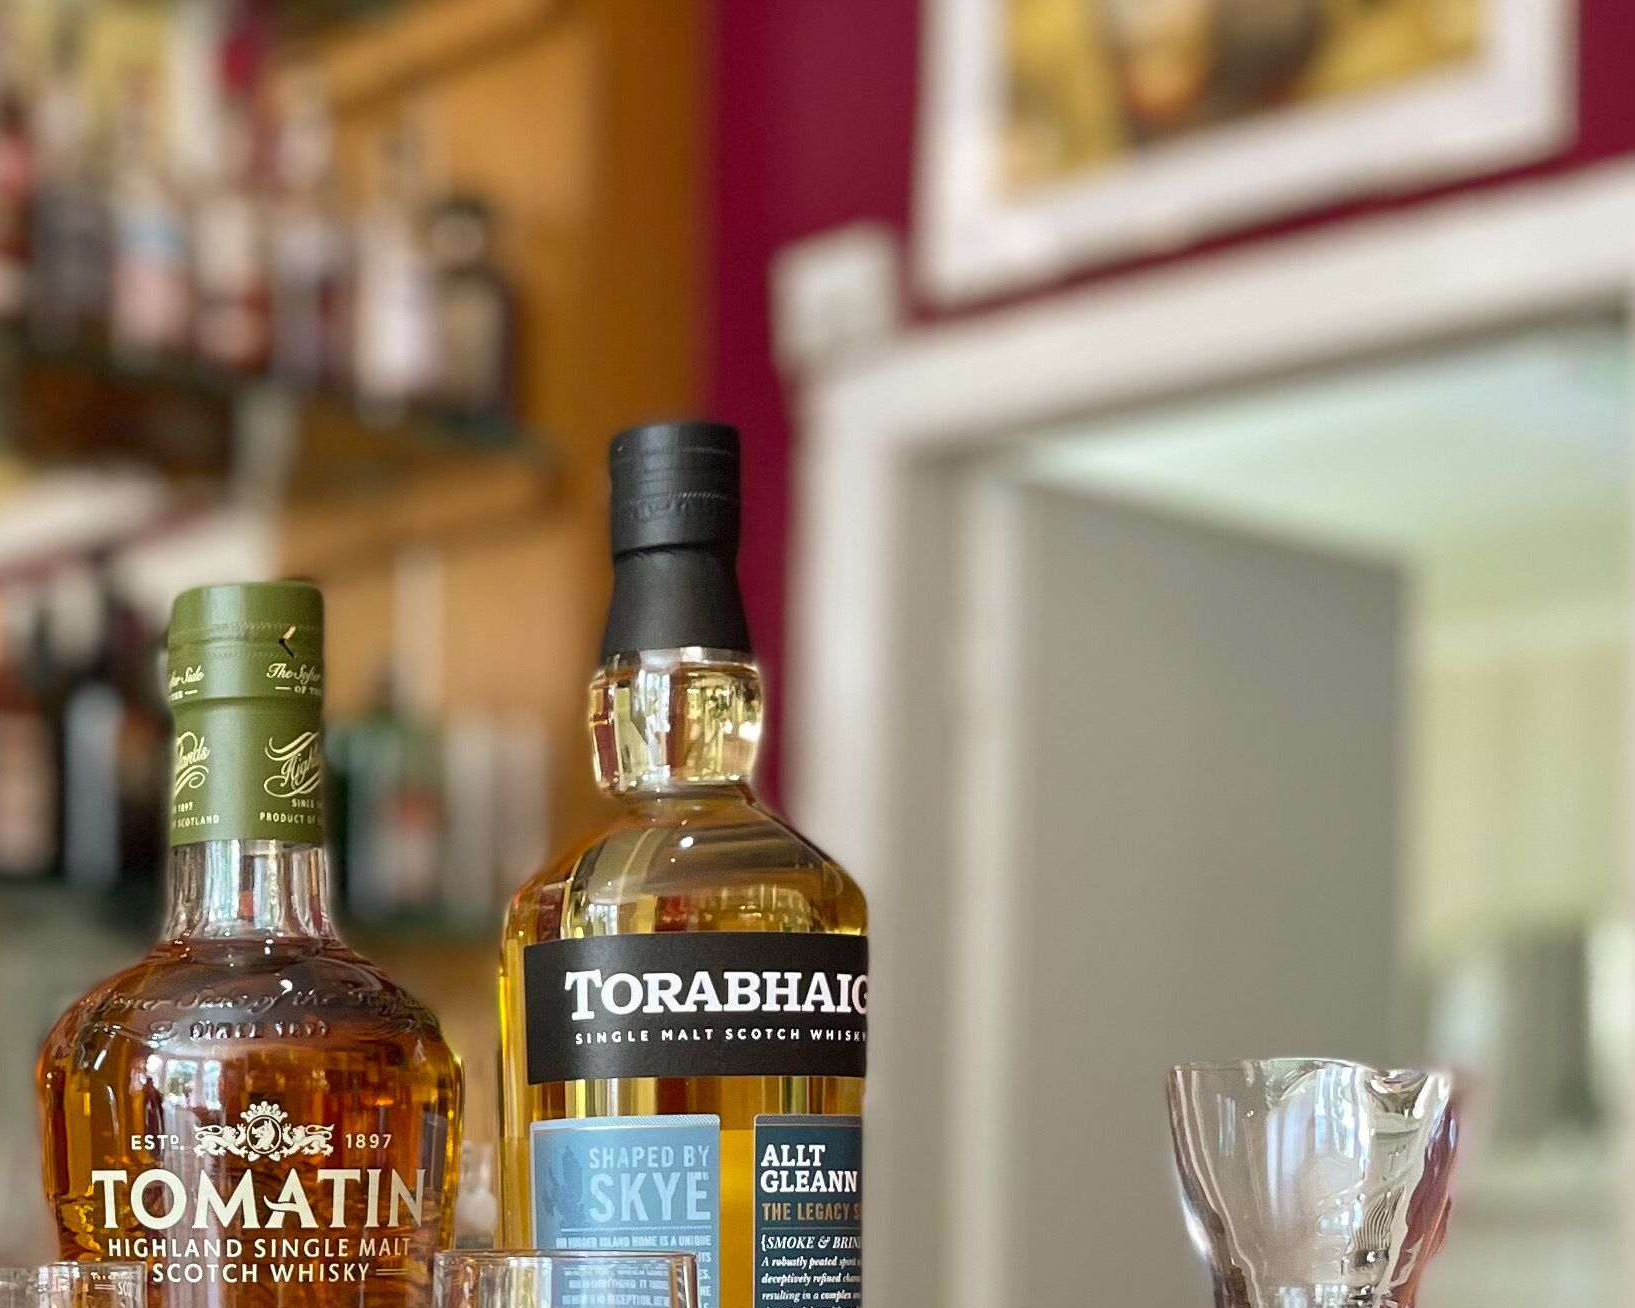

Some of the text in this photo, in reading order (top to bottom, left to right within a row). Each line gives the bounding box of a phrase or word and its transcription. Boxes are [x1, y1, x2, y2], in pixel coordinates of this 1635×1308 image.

[259, 811, 305, 824] PRODUCT
[575, 1031, 649, 1045] SINGLE
[661, 1029, 714, 1041] MALT
[725, 1028, 800, 1041] SCOTCH
[345, 1133, 393, 1149] 1897
[589, 1145, 710, 1169] SHAPED BY
[761, 1144, 826, 1167] ALLT
[760, 1170, 858, 1194] GLEANN
[92, 1168, 427, 1230] TOMATIN
[590, 1172, 711, 1222] SKYE
[762, 1204, 791, 1222] THE
[797, 1202, 850, 1221] LEGACY
[108, 1238, 410, 1258] HIGHLAND SINGLE MALT
[817, 1235, 831, 1249] &
[152, 1263, 370, 1283] SCOTCH WHISKY
[771, 1256, 808, 1270] robustly
[808, 1256, 838, 1270] peated
[761, 1273, 811, 1287] deceptively
[812, 1272, 842, 1287] refined
[761, 1290, 801, 1303] resulting
